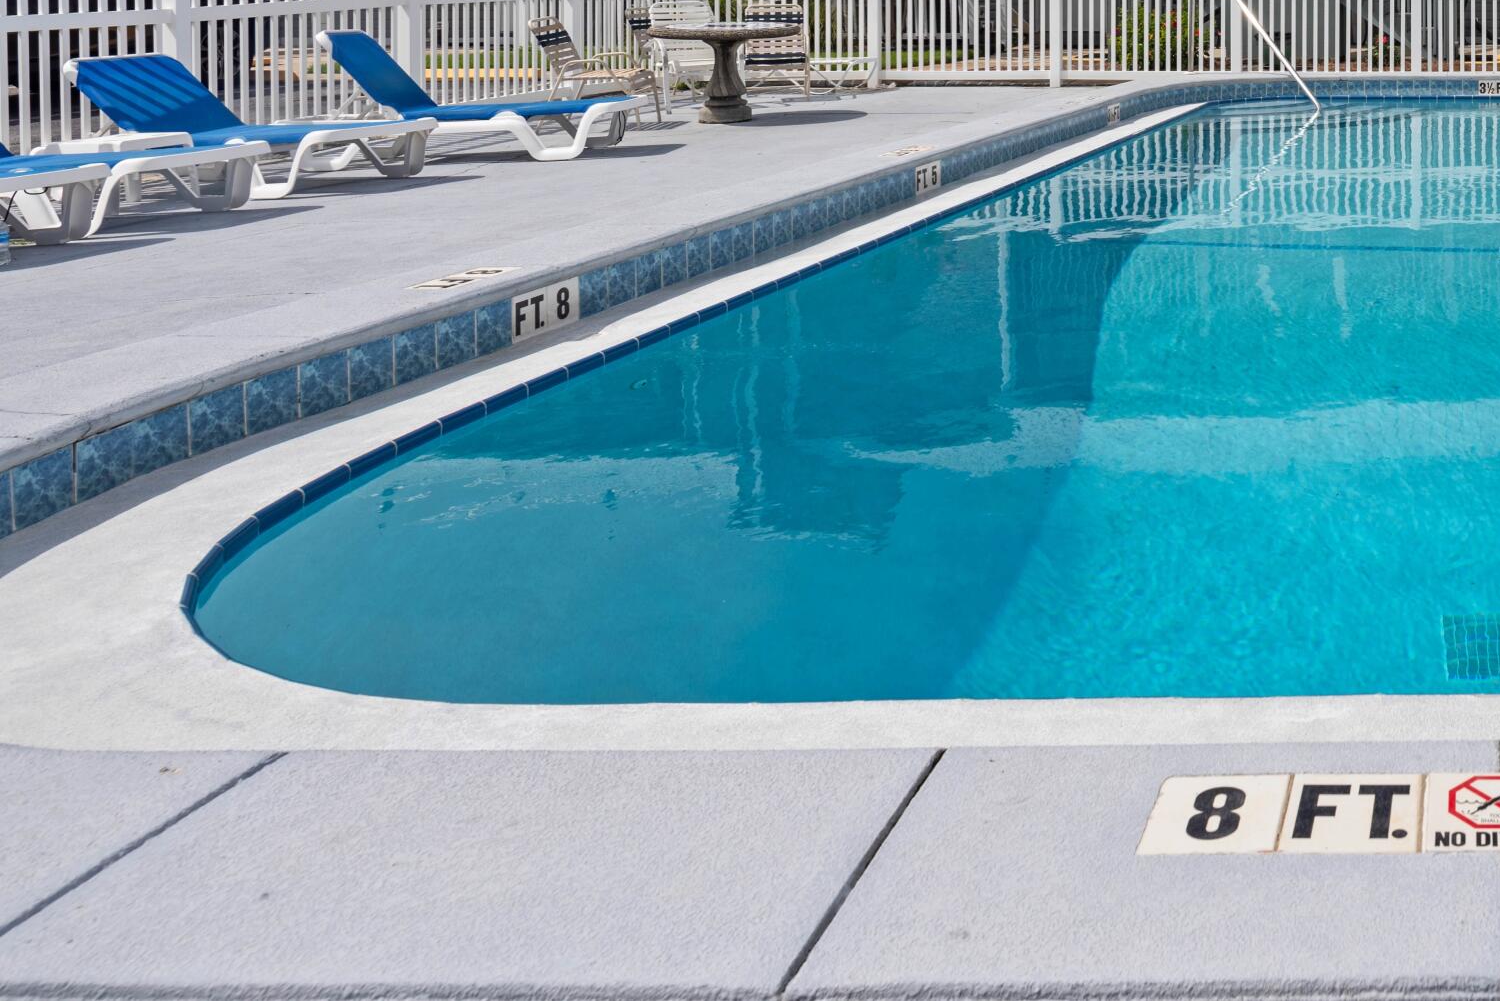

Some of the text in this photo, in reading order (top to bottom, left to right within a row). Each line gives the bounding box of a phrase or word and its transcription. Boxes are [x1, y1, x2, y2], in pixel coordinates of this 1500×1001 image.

[931, 165, 938, 186] 5
[515, 287, 570, 337] FT. 8
[1185, 784, 1411, 841] 8 FT.
[1434, 831, 1466, 847] NO
